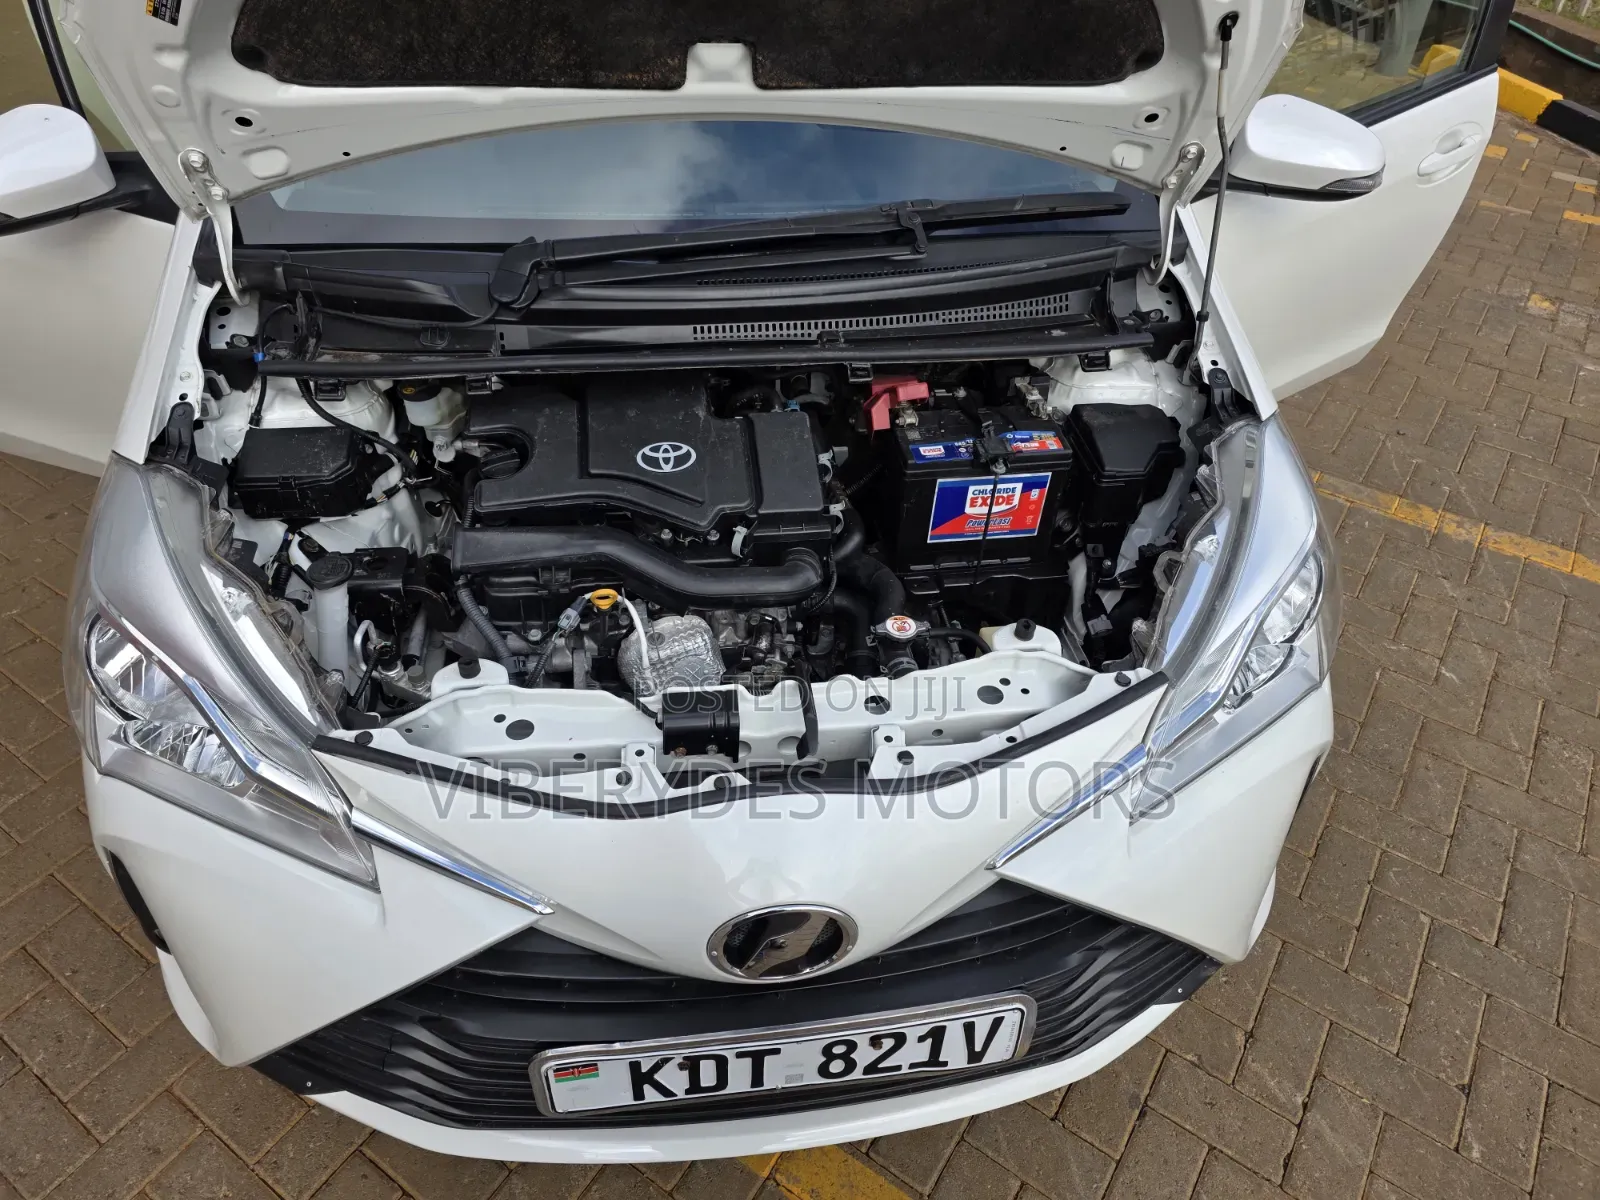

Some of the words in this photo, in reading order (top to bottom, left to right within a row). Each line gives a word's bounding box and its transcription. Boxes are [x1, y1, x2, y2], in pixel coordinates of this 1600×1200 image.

[969, 494, 1016, 508] EXDE
[966, 517, 1012, 527] PowrLast
[629, 1048, 781, 1101] KDT
[817, 1016, 1004, 1079] 821V
